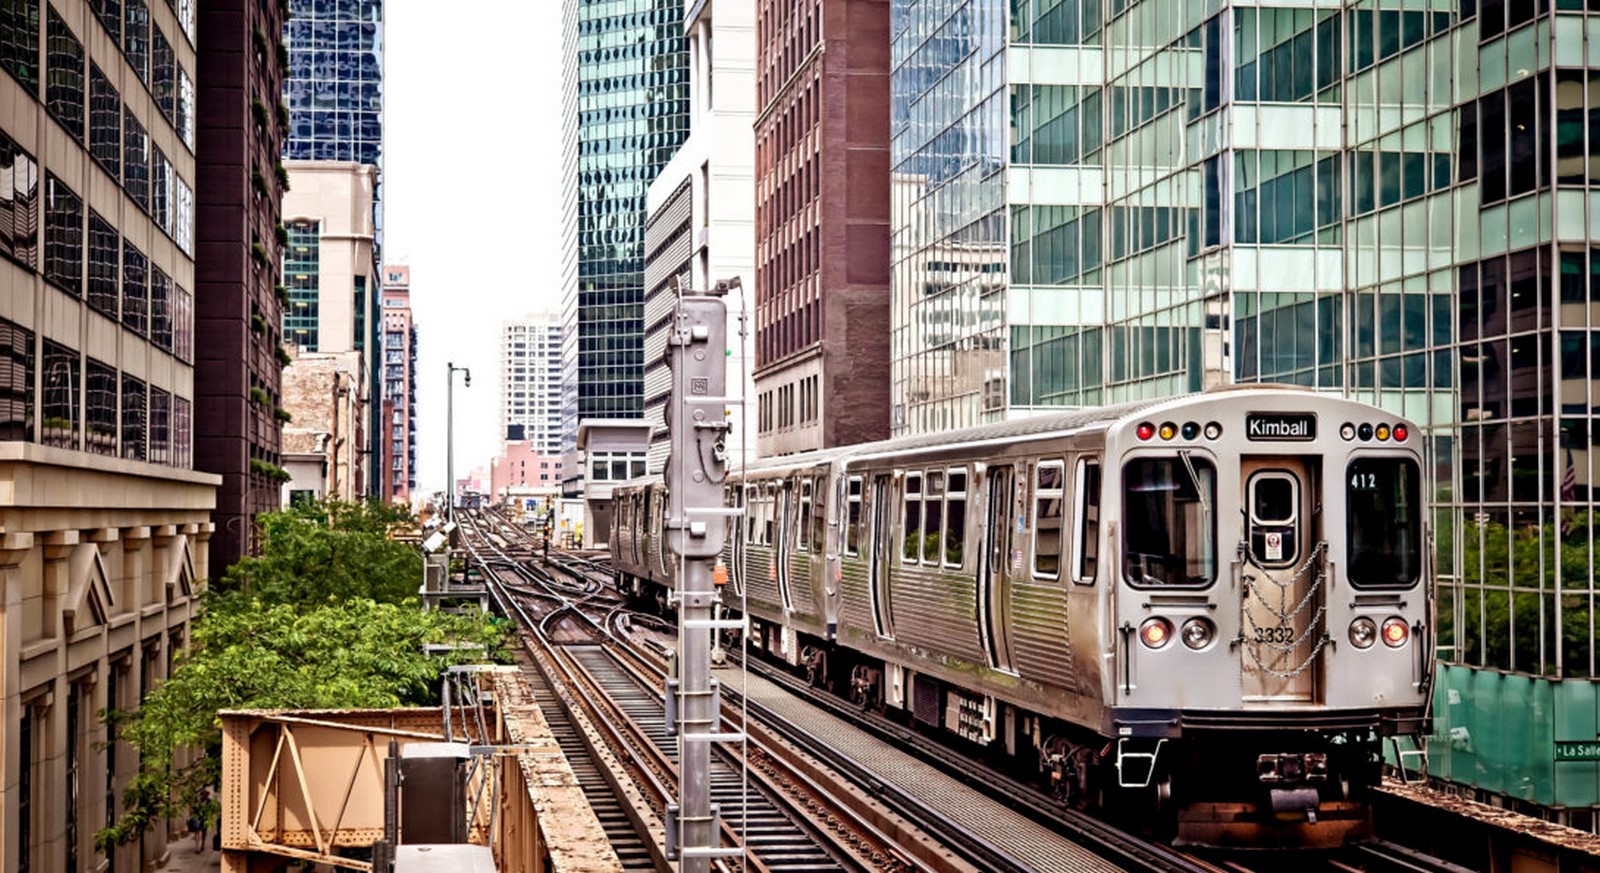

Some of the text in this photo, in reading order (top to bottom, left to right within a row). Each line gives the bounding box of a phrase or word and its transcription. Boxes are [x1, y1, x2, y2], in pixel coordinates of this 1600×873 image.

[1250, 419, 1308, 435] Kimball
[1351, 473, 1376, 489] 412
[1254, 627, 1294, 643] 3332
[1563, 745, 1576, 757] La
